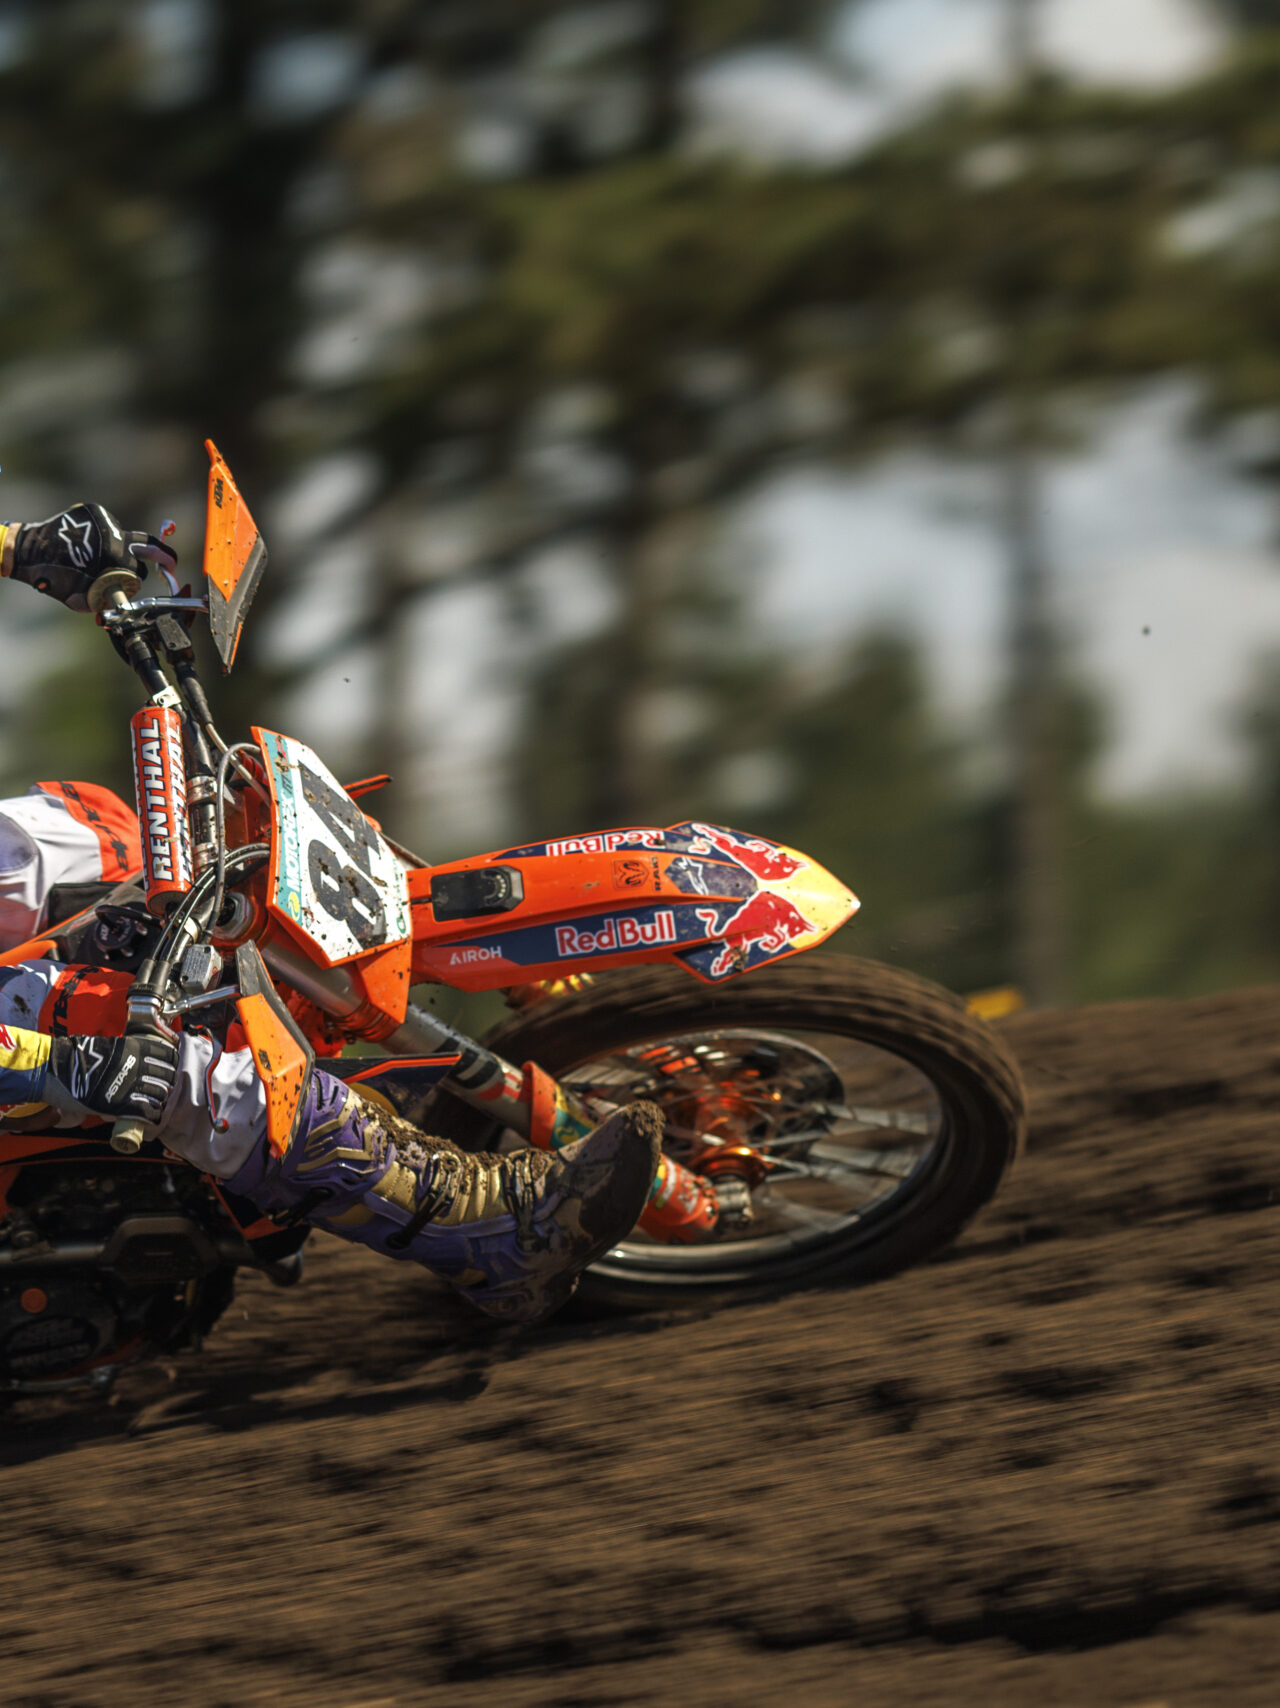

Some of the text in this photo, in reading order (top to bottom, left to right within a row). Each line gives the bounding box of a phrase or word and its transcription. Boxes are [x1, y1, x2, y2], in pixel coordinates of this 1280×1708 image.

[140, 717, 174, 882] RENTHAL
[281, 790, 301, 892] MOTOREX
[297, 759, 388, 951] 84
[546, 830, 666, 857] Red Bull
[449, 946, 502, 965] AIROH
[555, 911, 676, 956] Red Bull
[105, 1054, 137, 1103] ASTARS
